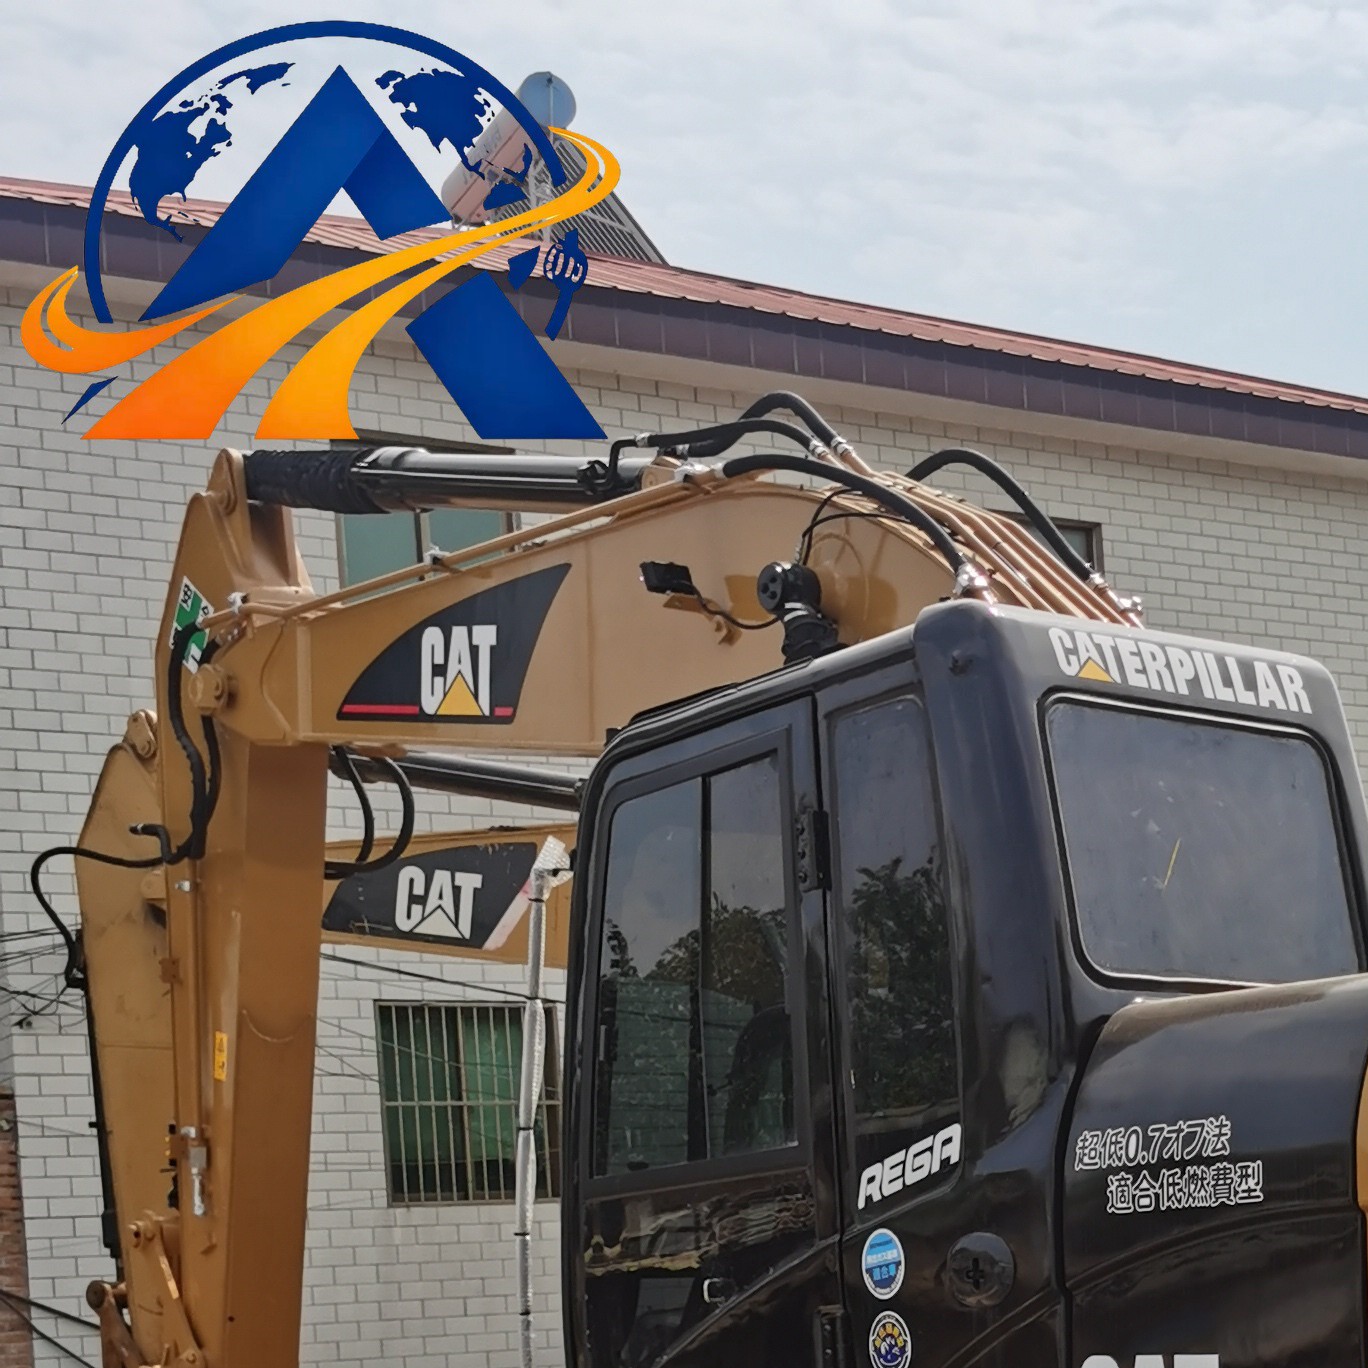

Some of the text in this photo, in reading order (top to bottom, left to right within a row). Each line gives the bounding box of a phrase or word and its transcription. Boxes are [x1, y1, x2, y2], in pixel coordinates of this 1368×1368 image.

[420, 624, 498, 717] CAT
[1048, 626, 1313, 715] CATERPILLAR
[394, 865, 483, 940] CAT
[857, 1122, 962, 1211] REGA
[1074, 1115, 1231, 1172] 超低0.7オフ法
[1106, 1160, 1265, 1214] 適合低燃費型
